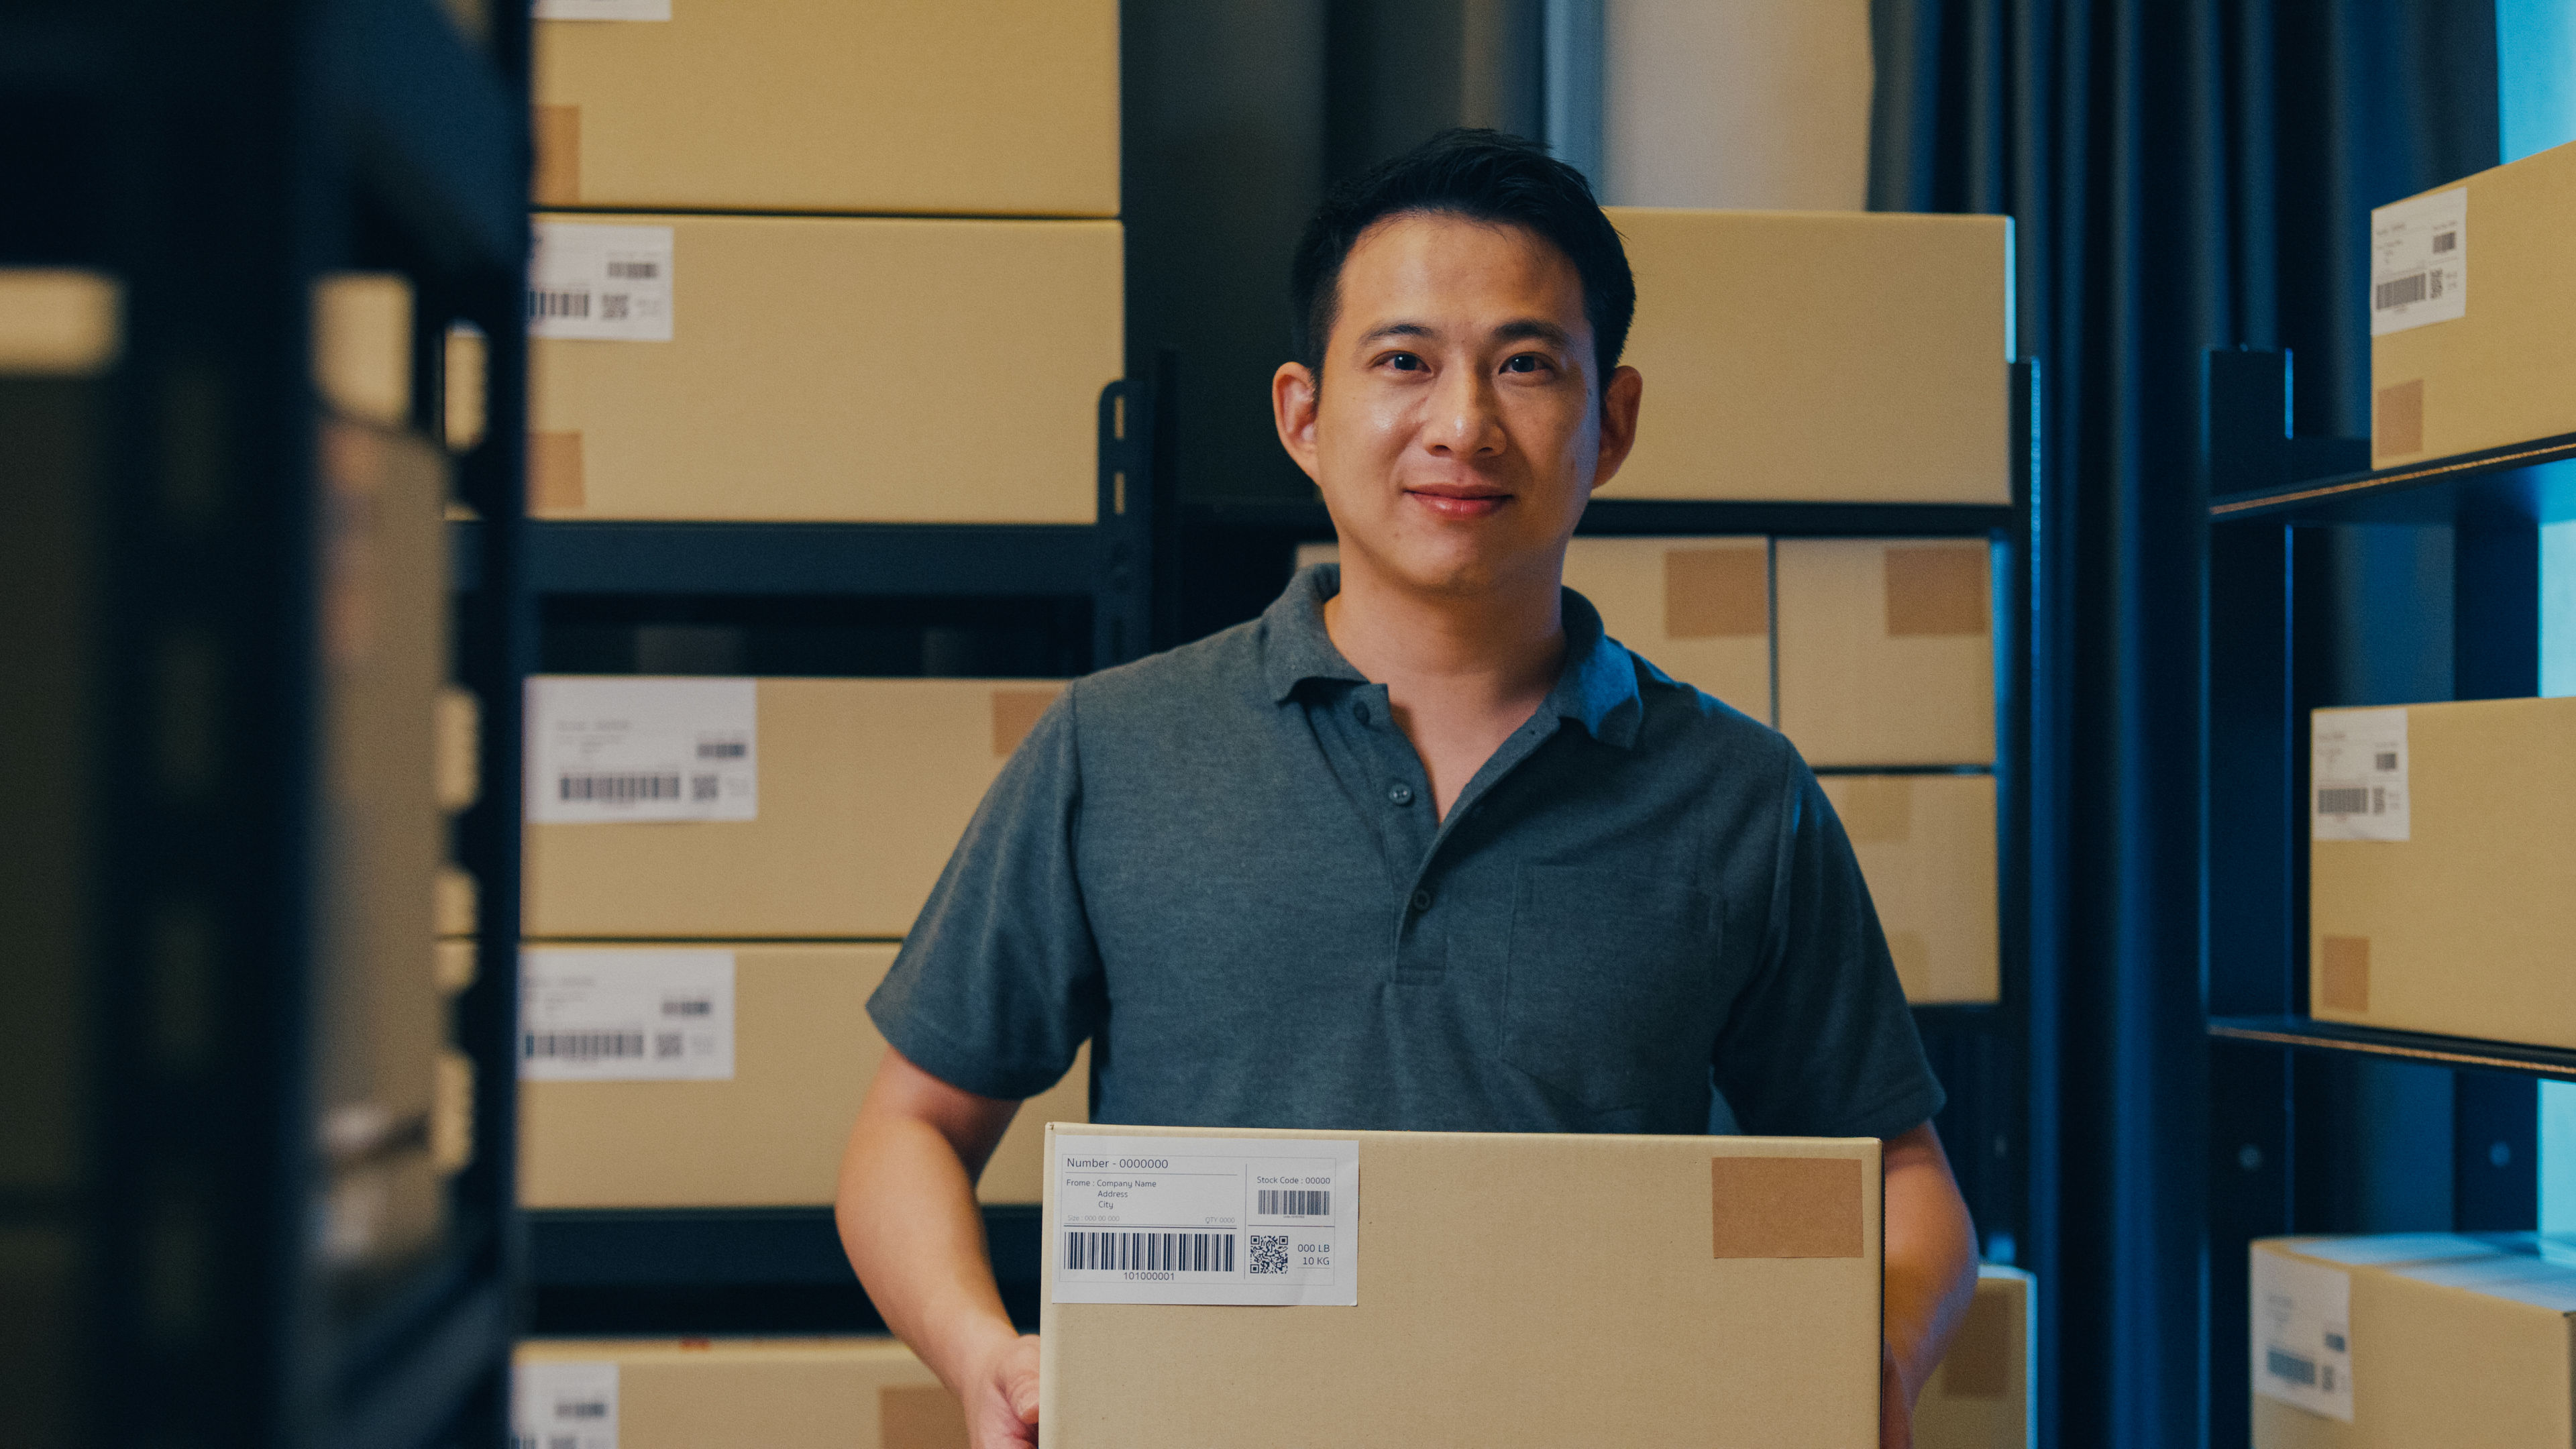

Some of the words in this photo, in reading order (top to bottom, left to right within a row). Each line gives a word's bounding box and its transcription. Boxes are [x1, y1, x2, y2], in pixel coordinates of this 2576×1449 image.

[1067, 1158, 1110, 1168] Number
[1119, 1159, 1169, 1169] 0000000
[1097, 1179, 1132, 1188] Company
[1098, 1201, 1114, 1210] City
[1297, 1244, 1316, 1252] 000
[1318, 1244, 1330, 1252] LB
[1303, 1256, 1314, 1265] 10
[1317, 1256, 1330, 1265] KG
[1124, 1271, 1175, 1281] 101000001
